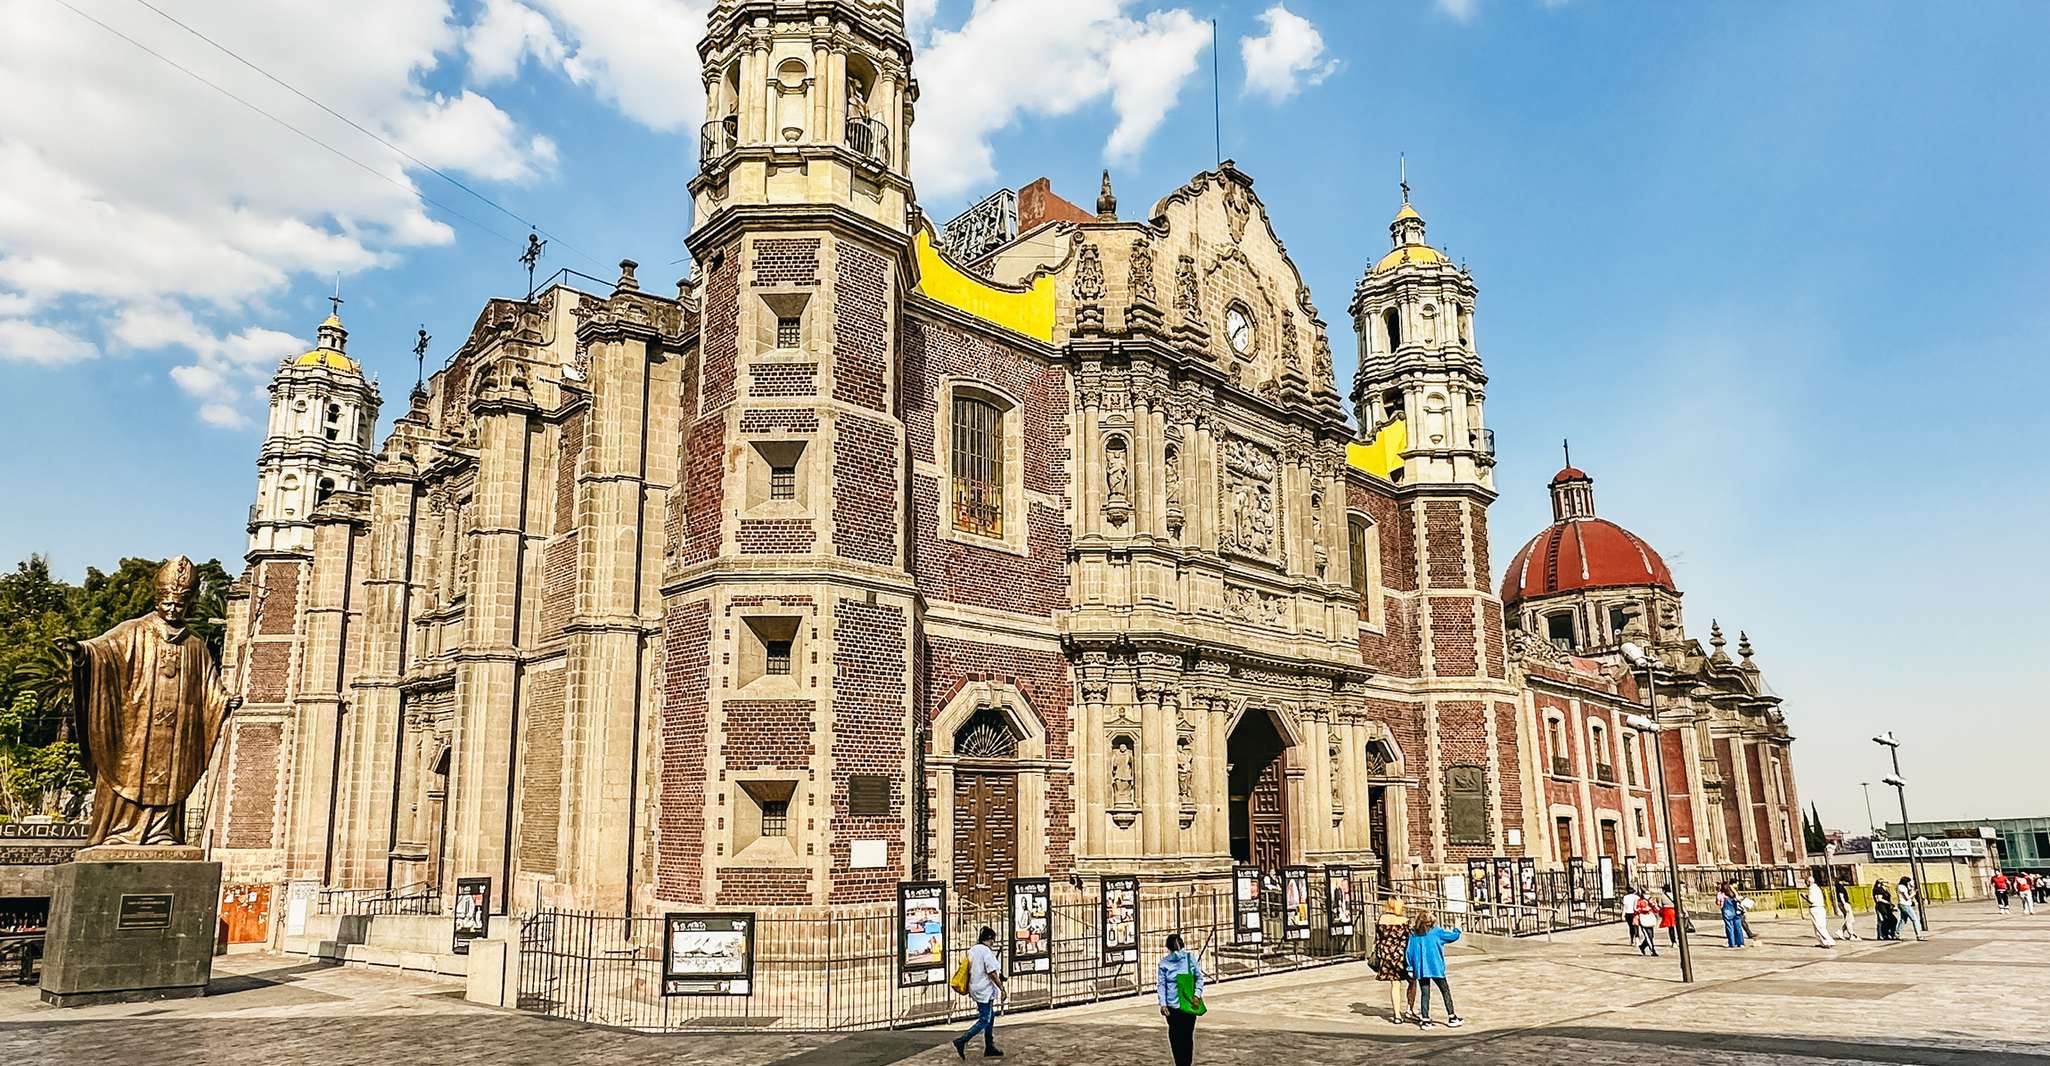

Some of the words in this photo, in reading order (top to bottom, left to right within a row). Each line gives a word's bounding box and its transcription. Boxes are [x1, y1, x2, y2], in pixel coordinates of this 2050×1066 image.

[0, 825, 88, 837] EMORIAL
[1876, 842, 1909, 850] ARTICULO
[1915, 847, 1952, 856] GADALUPE
